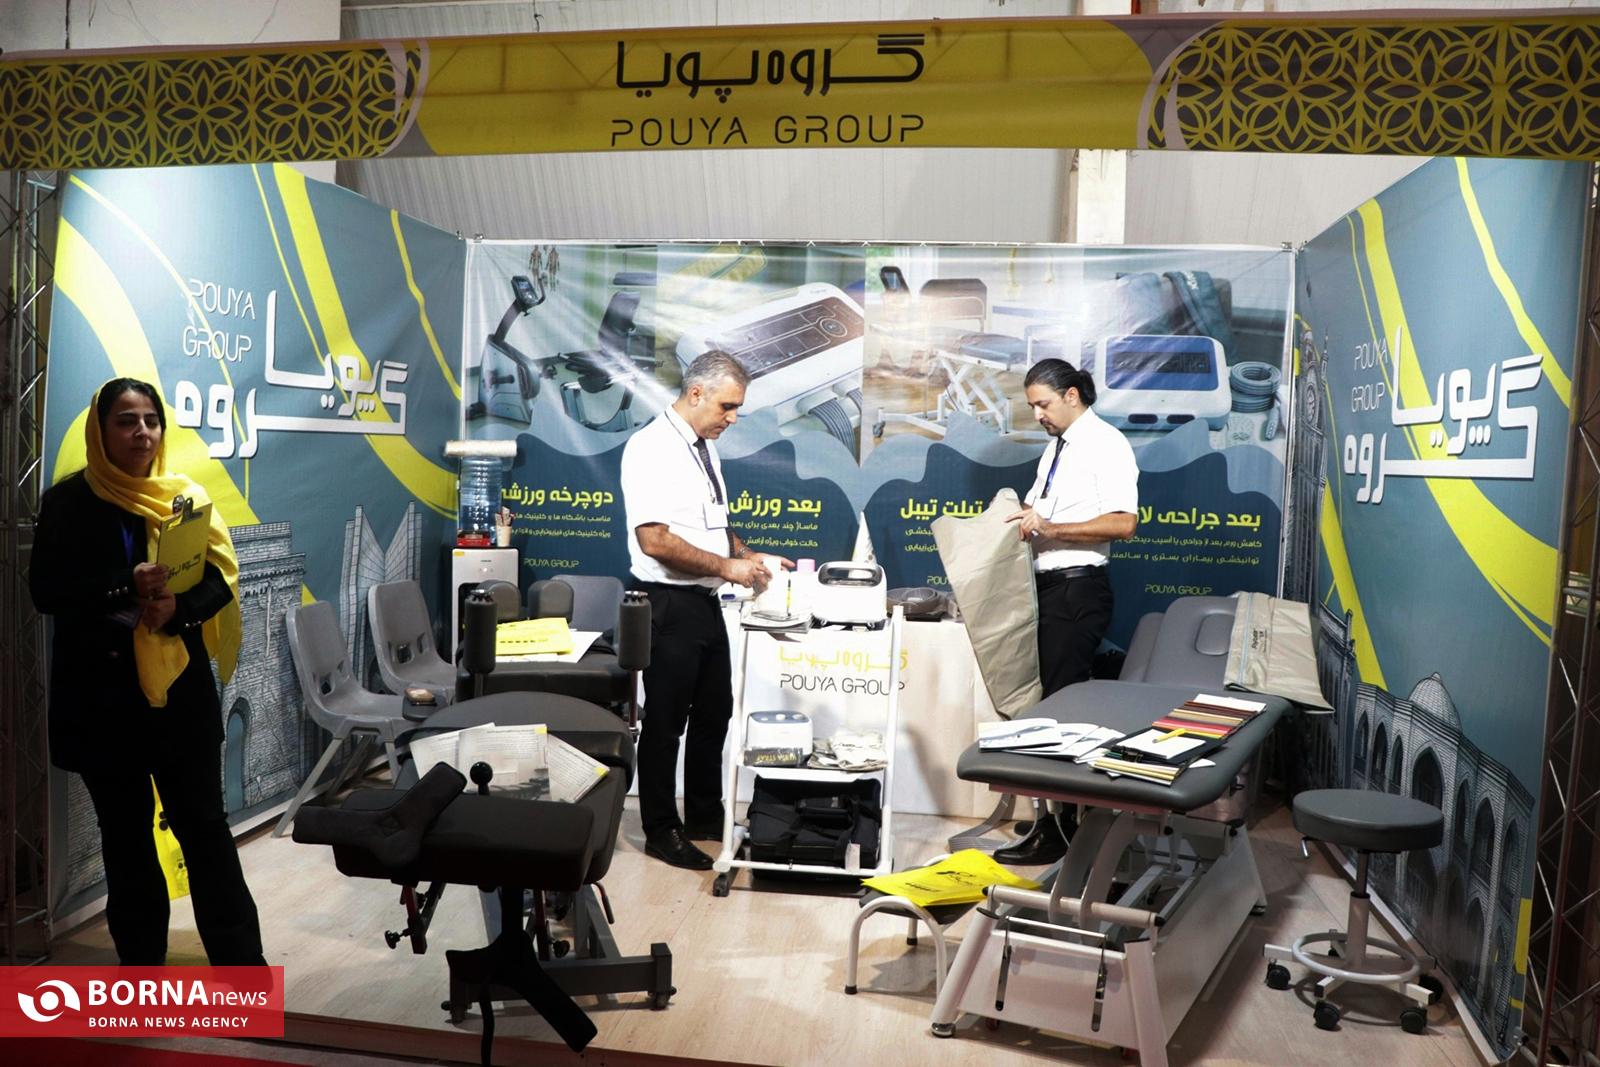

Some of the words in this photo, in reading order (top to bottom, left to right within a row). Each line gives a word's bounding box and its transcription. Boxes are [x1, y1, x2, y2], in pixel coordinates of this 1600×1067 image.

[616, 41, 760, 104] پویا
[765, 33, 926, 97] گروه
[611, 116, 748, 147] POUYA
[774, 114, 925, 145] GROUP
[187, 279, 256, 320] POUYA
[182, 326, 253, 362] GROUP
[264, 290, 382, 417] پویا
[1353, 338, 1389, 372] POUYA
[1351, 382, 1386, 413] GROUP
[1391, 324, 1497, 456] پویا
[174, 361, 409, 459] گروه
[1344, 353, 1544, 504] گروه
[549, 486, 614, 510] دوچرخه
[729, 490, 782, 517] ورزش
[787, 499, 822, 518] بعد
[1157, 507, 1221, 531] جراحی
[1226, 513, 1261, 532] بعد
[523, 557, 549, 568] POUYA
[550, 559, 580, 569] GROUP
[1144, 584, 1177, 594] POUYA
[1177, 585, 1213, 595] GROUP
[780, 673, 838, 692] POUYA
